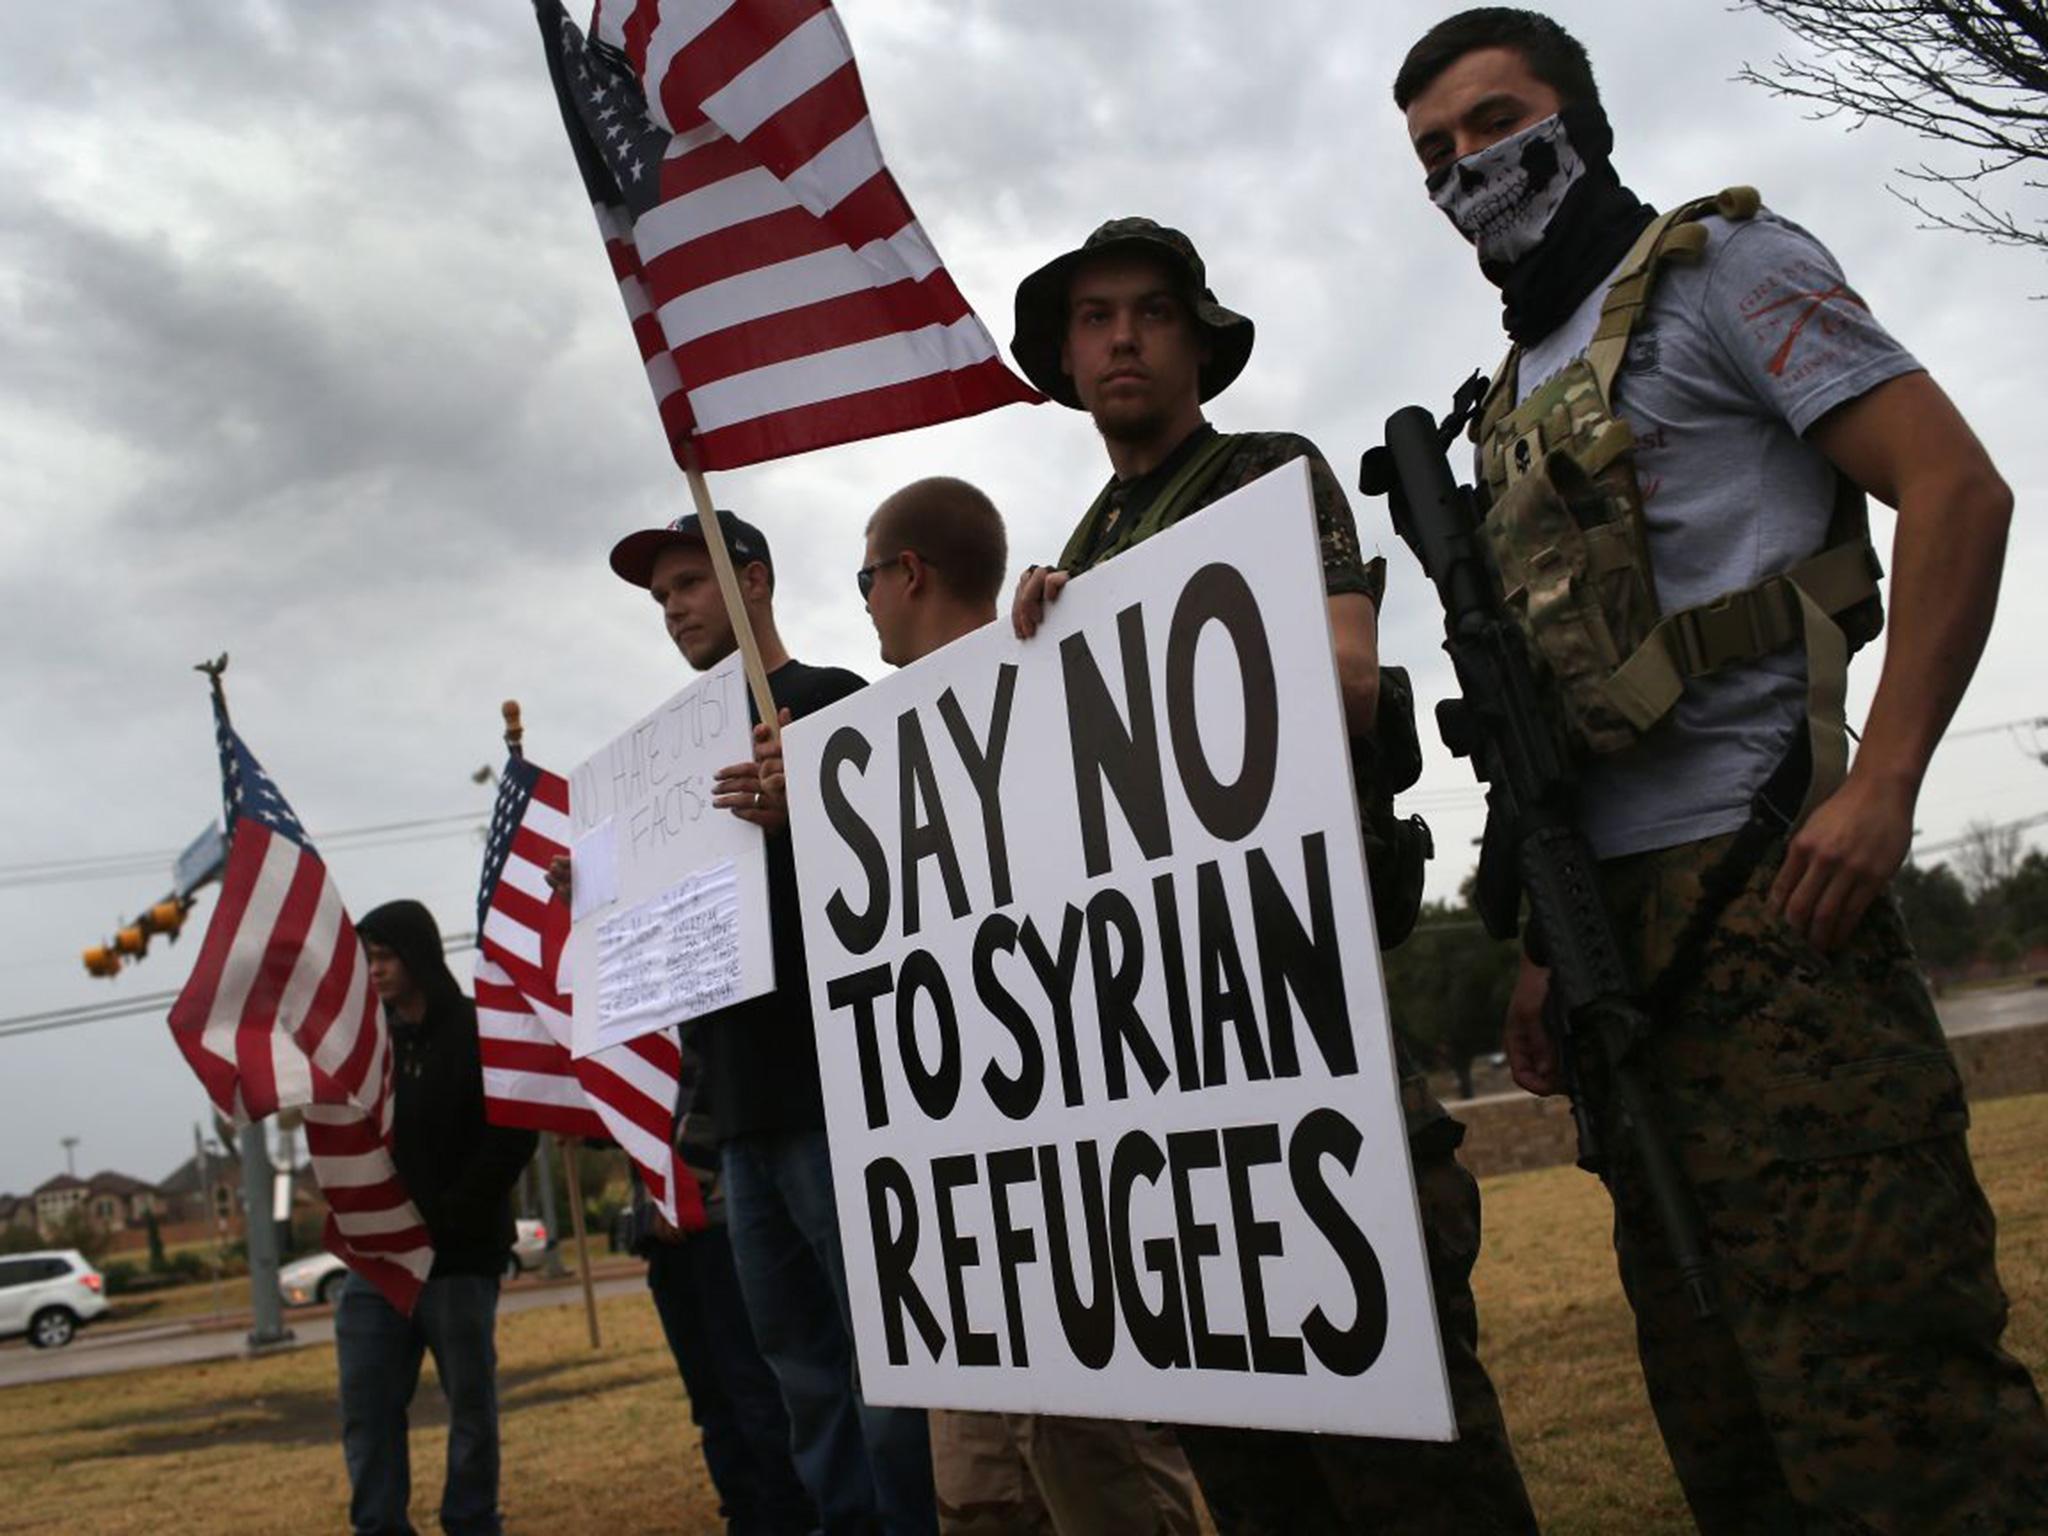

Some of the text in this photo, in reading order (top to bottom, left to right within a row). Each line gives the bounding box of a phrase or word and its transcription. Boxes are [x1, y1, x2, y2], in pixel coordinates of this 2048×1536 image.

[611, 719, 669, 815] HATE
[669, 670, 735, 760] JUST
[820, 563, 1278, 955] SAY NO
[827, 949, 961, 1129] TO
[973, 832, 1358, 1120] SYRIAN
[864, 1108, 1388, 1376] REFUGEES
